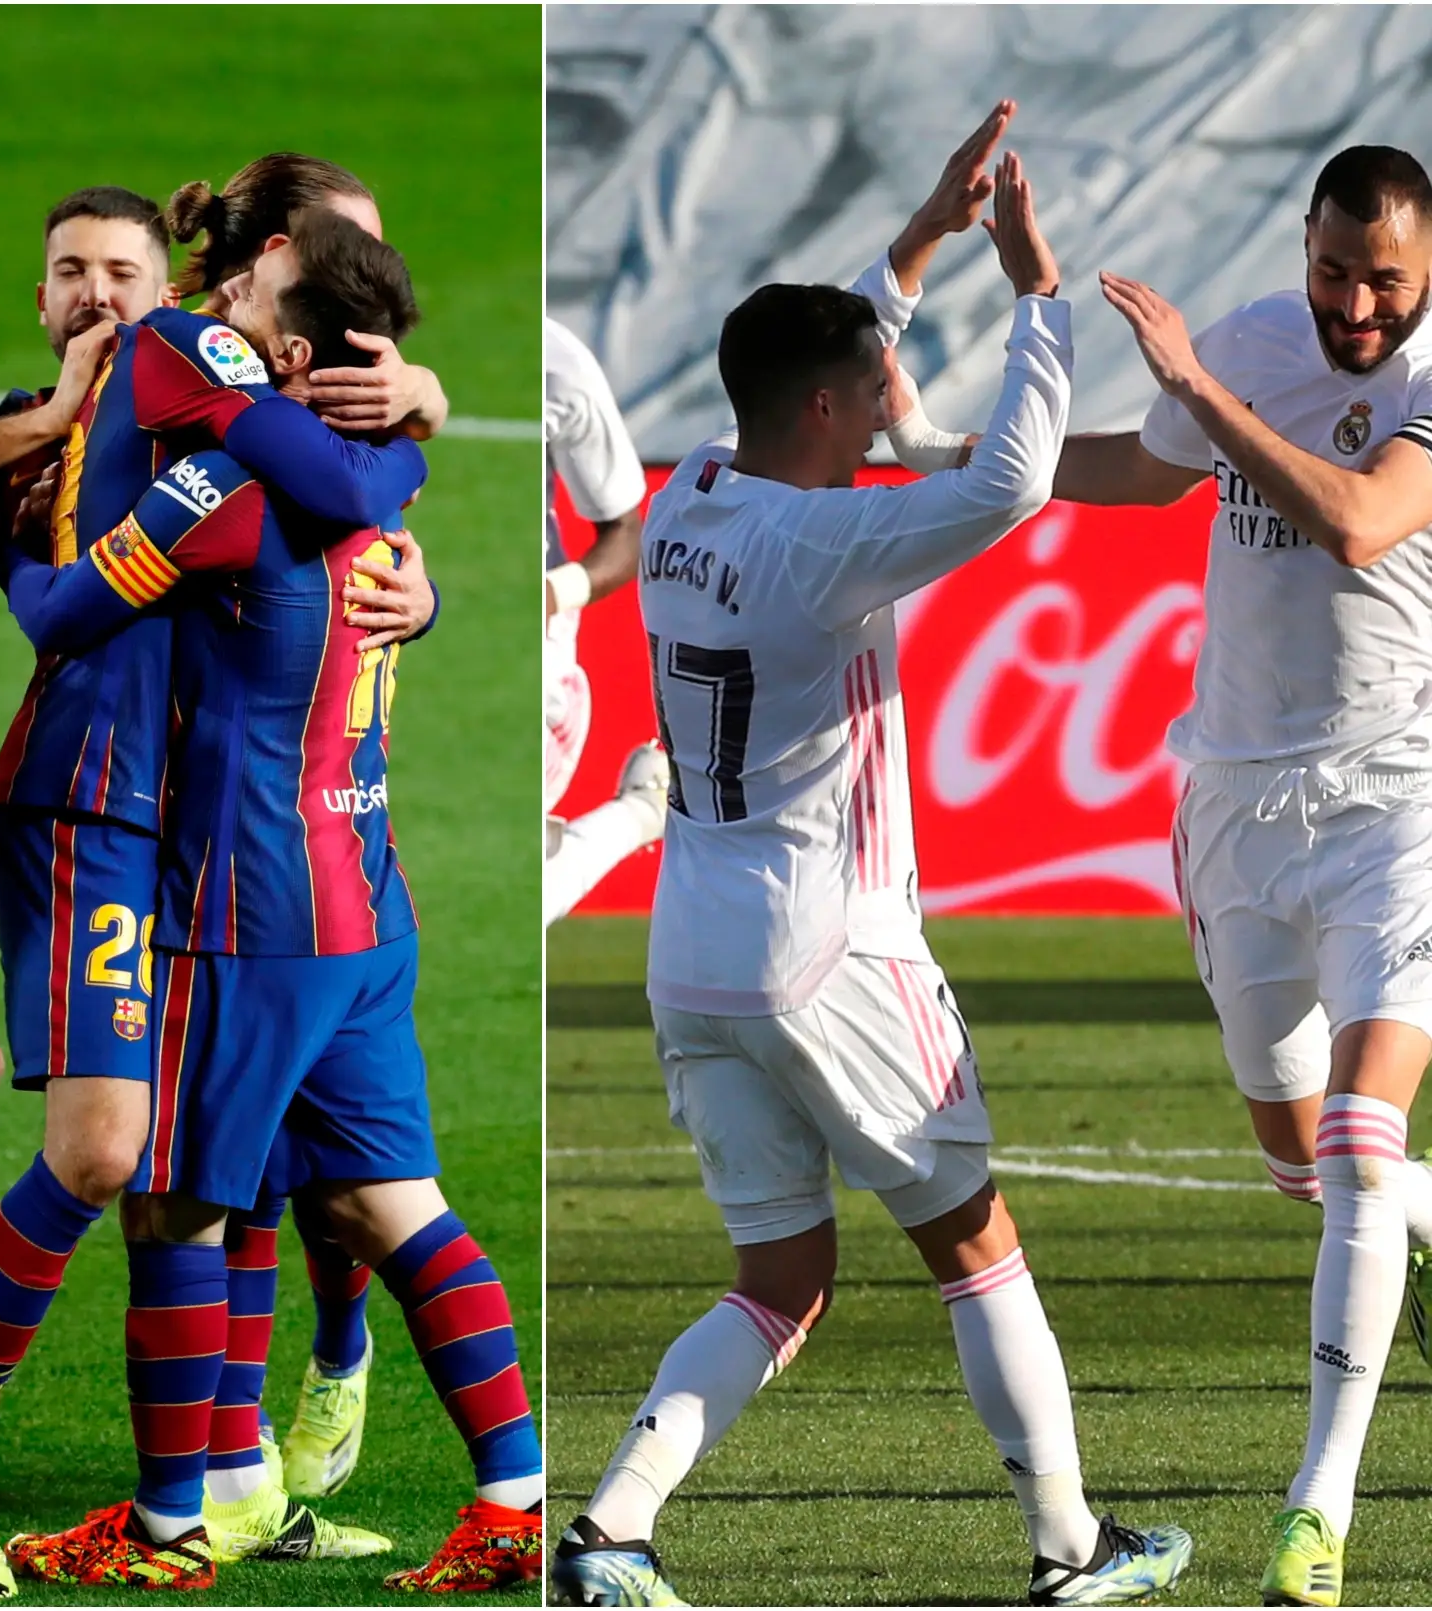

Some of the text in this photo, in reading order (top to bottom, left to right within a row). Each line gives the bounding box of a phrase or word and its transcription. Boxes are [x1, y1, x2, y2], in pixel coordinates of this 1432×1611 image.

[228, 362, 264, 383] LaLiga
[1229, 511, 1259, 547] FLY
[641, 539, 740, 616] LUCAS V.
[648, 632, 755, 824] 17
[1313, 1350, 1367, 1374] MADRID
[1318, 1341, 1352, 1364] REAL
